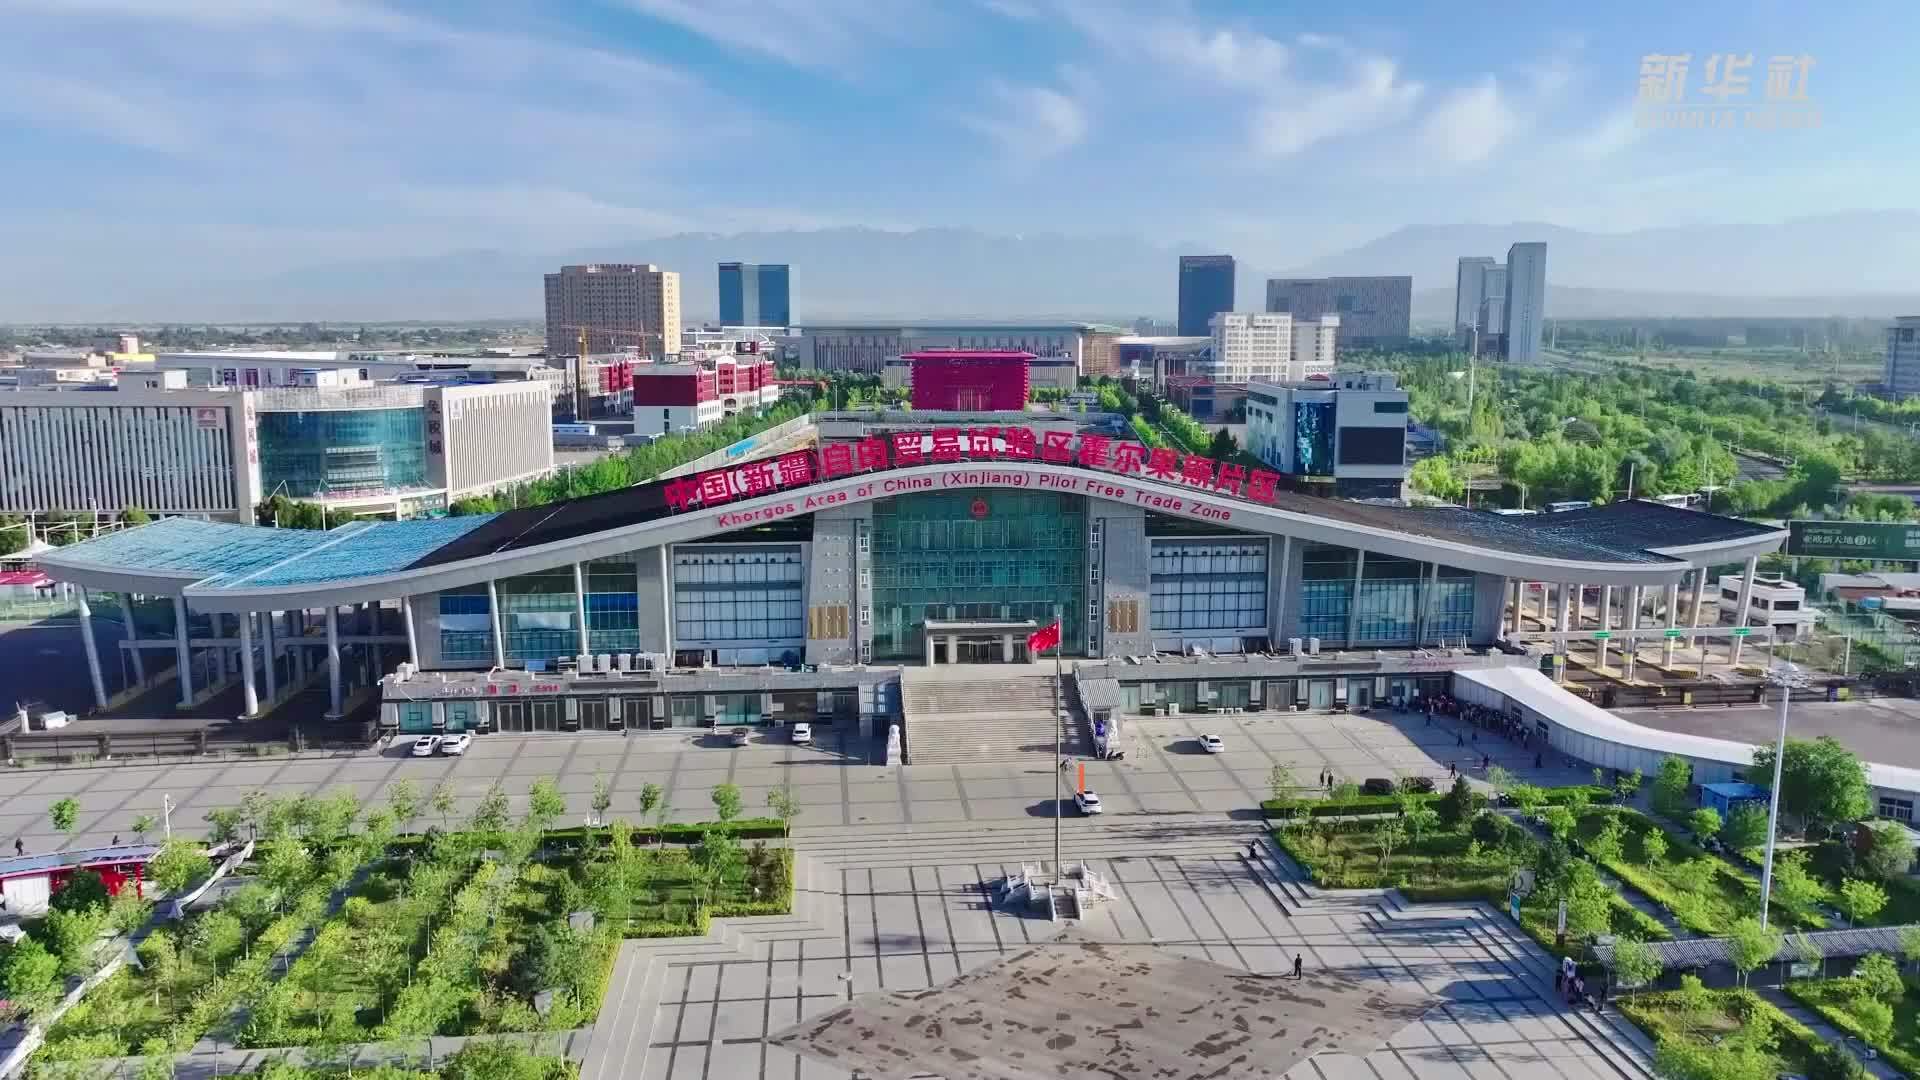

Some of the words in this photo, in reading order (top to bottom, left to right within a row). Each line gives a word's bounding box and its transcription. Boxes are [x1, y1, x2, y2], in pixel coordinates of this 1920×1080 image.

[718, 502, 796, 528] Khorgos
[804, 491, 848, 510] Area
[857, 483, 873, 497] of
[884, 476, 933, 493] China
[942, 471, 1031, 488] (Xinjiang)
[1039, 474, 1077, 490] Pilot
[1085, 480, 1126, 499] Free
[1135, 490, 1183, 511] Trade
[1190, 502, 1232, 521] Zone
